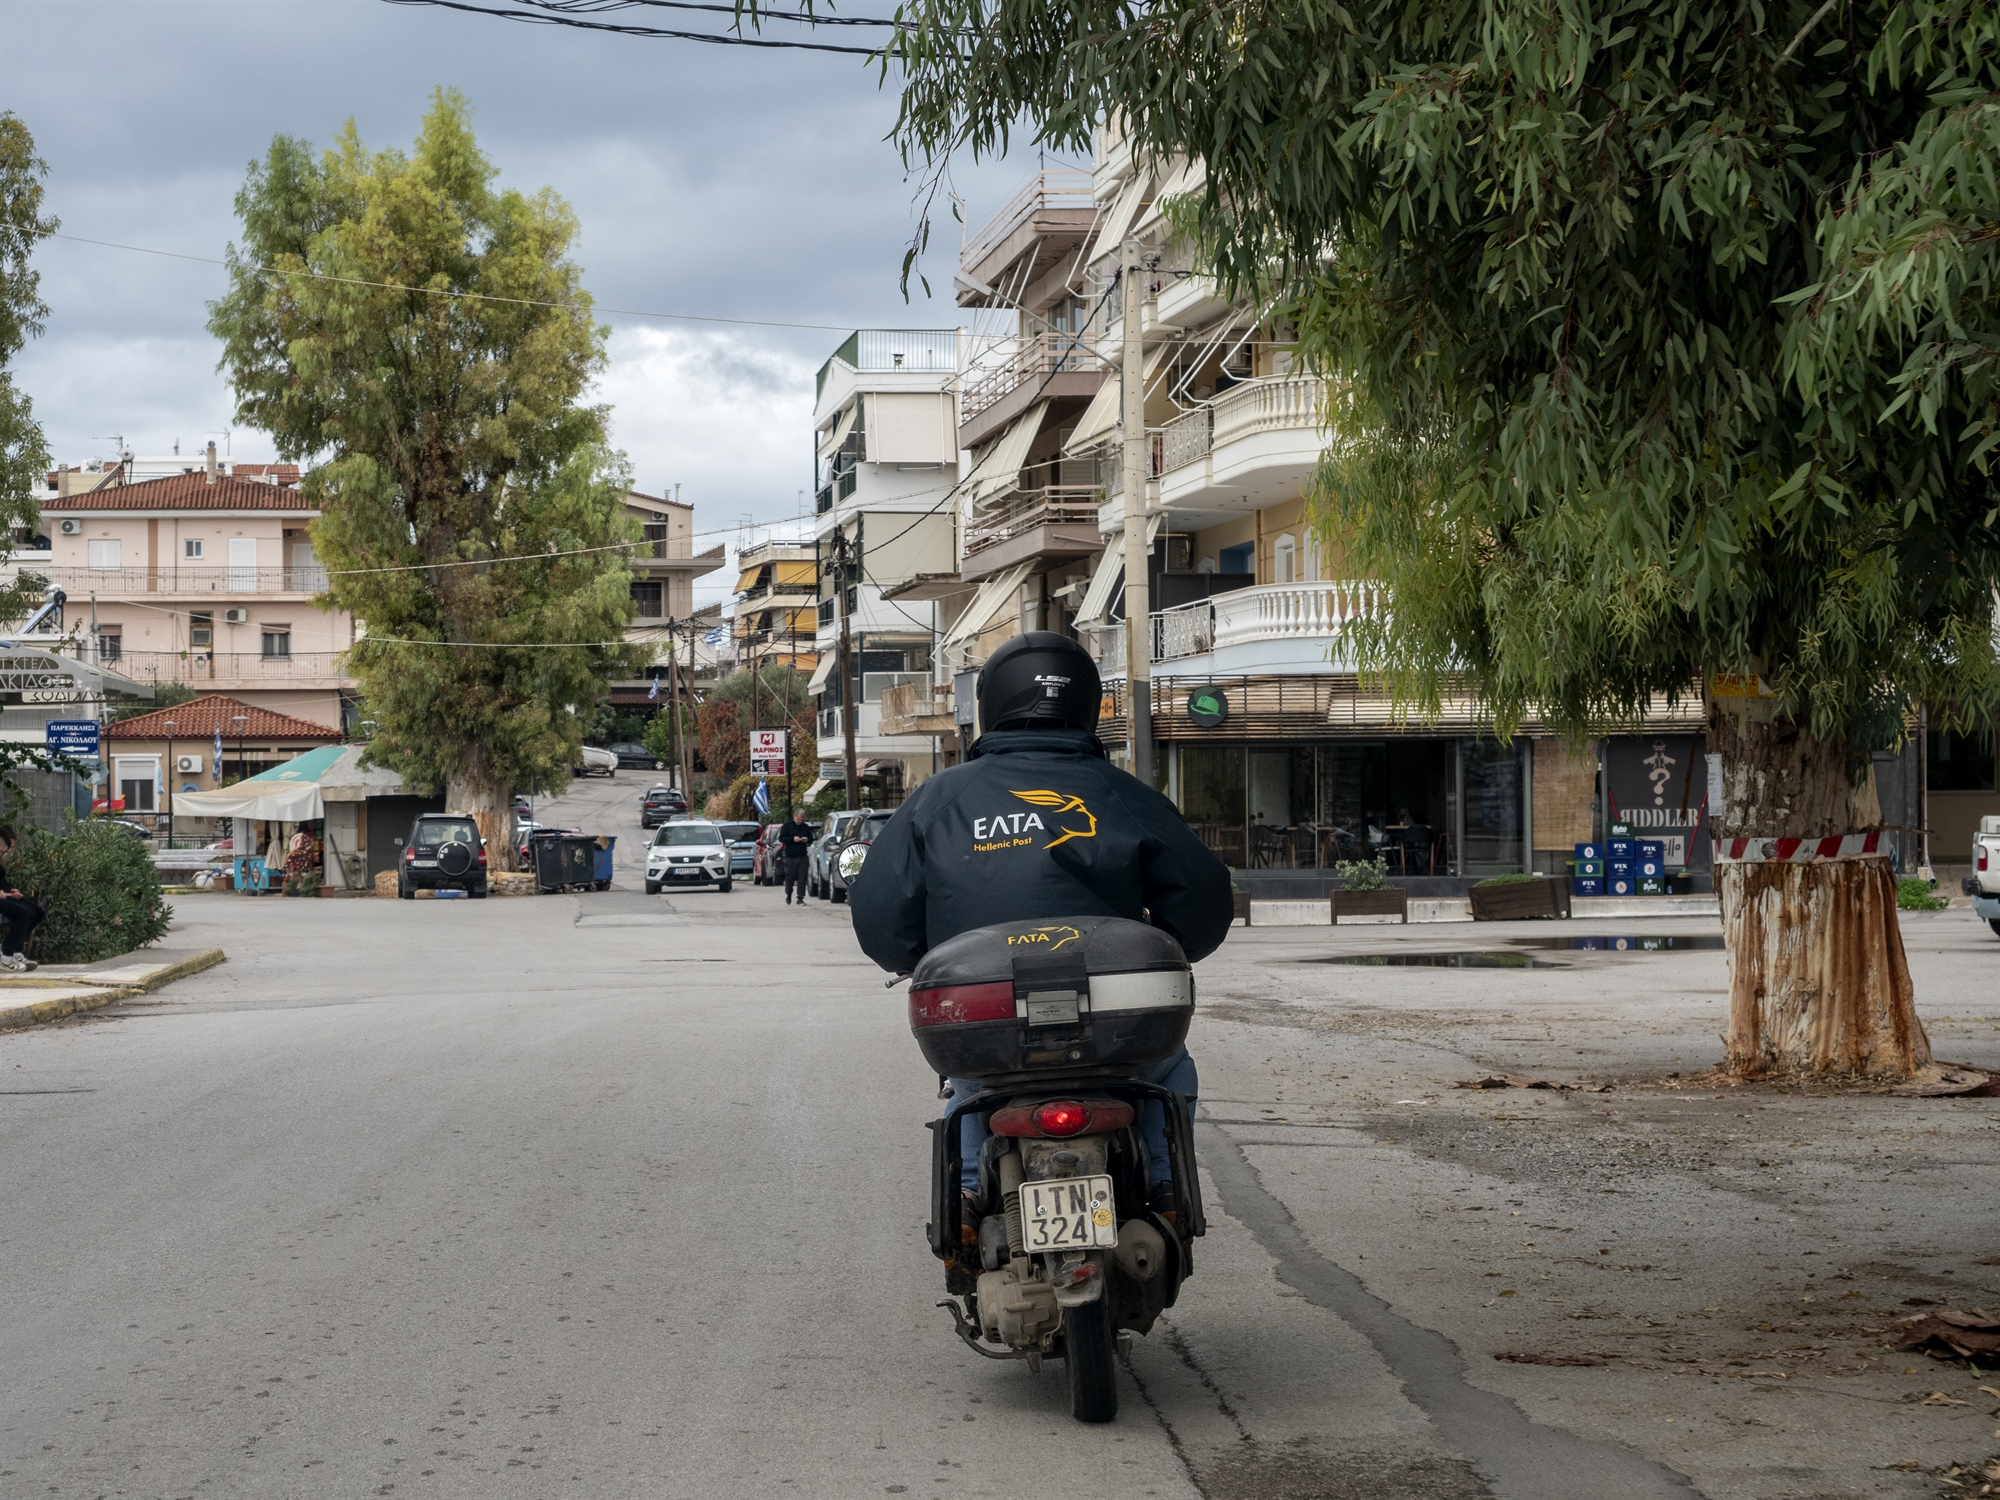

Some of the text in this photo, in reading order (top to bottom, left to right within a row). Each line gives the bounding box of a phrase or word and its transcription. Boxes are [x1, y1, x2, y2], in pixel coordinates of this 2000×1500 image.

[13, 657, 51, 670] ΚΤΕΛ
[48, 736, 98, 744] ΑΓ. ΝΙΚΟΛΑΟΥ
[974, 812, 1045, 840] ΕΛΤΑ
[973, 836, 1033, 852] Hellenic Post
[1031, 1214, 1088, 1246] 324
